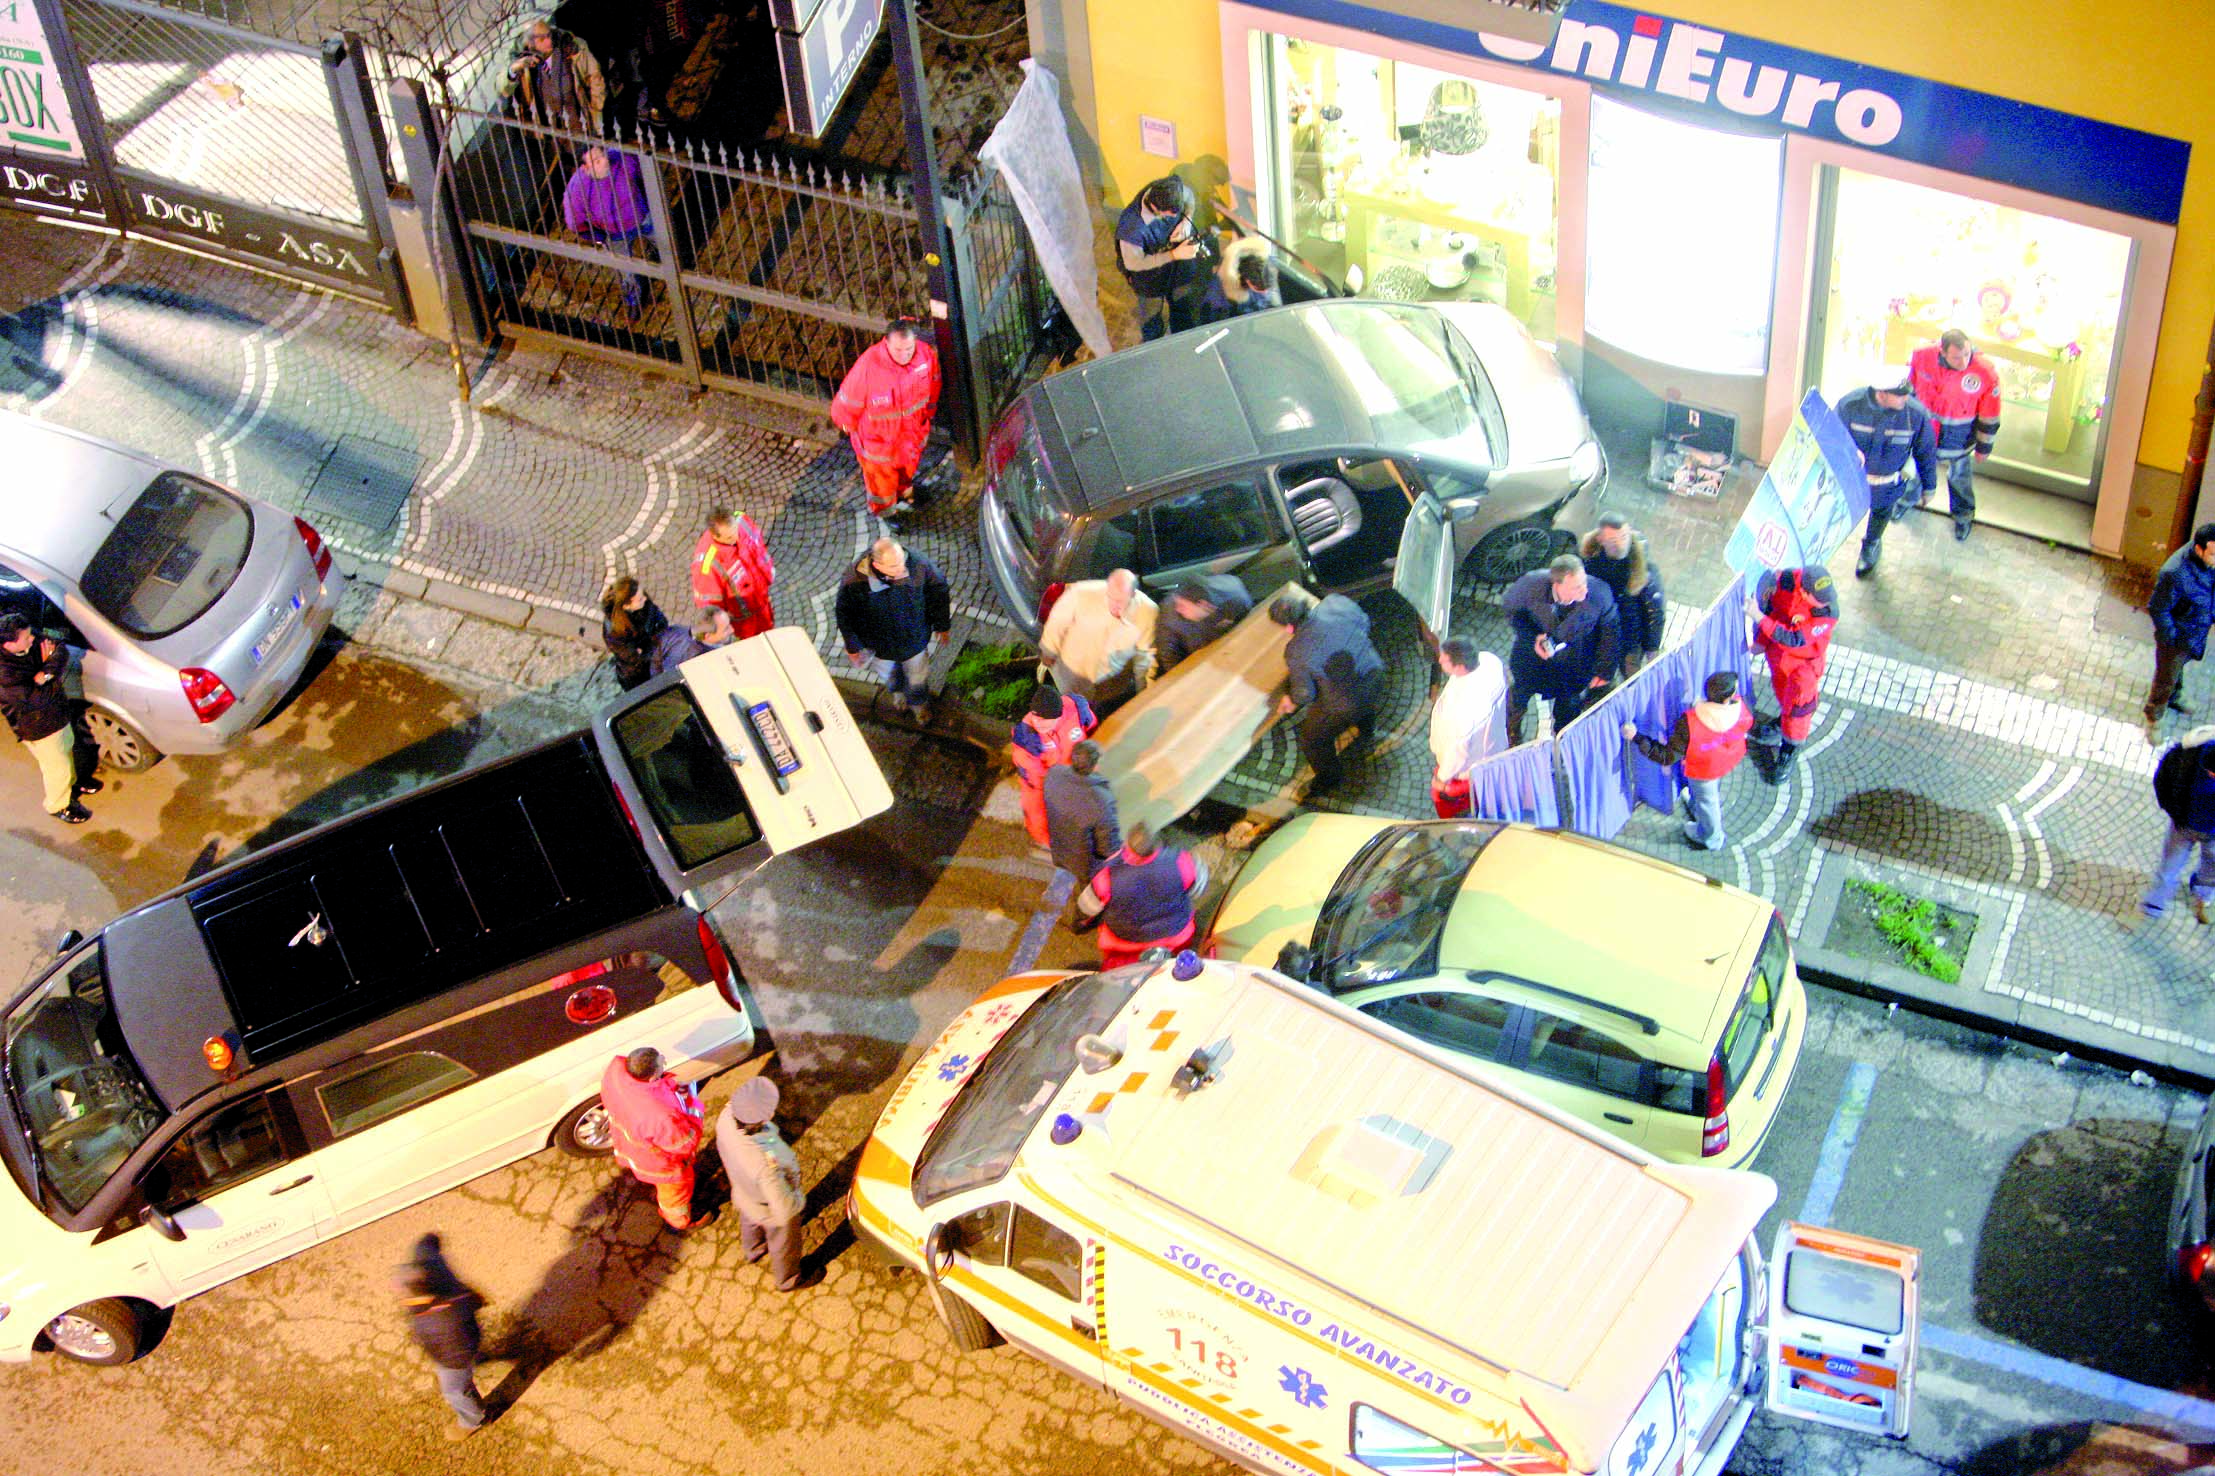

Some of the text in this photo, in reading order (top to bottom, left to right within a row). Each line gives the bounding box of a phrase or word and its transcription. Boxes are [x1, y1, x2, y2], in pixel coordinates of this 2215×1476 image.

[0, 65, 60, 133] OX
[820, 20, 873, 117] INTERNO
[141, 193, 225, 235] DGF
[278, 230, 369, 277] ASA
[1163, 1244, 1473, 1406] SOCCORSO AVANZATO
[1165, 1327, 1238, 1379] 118
